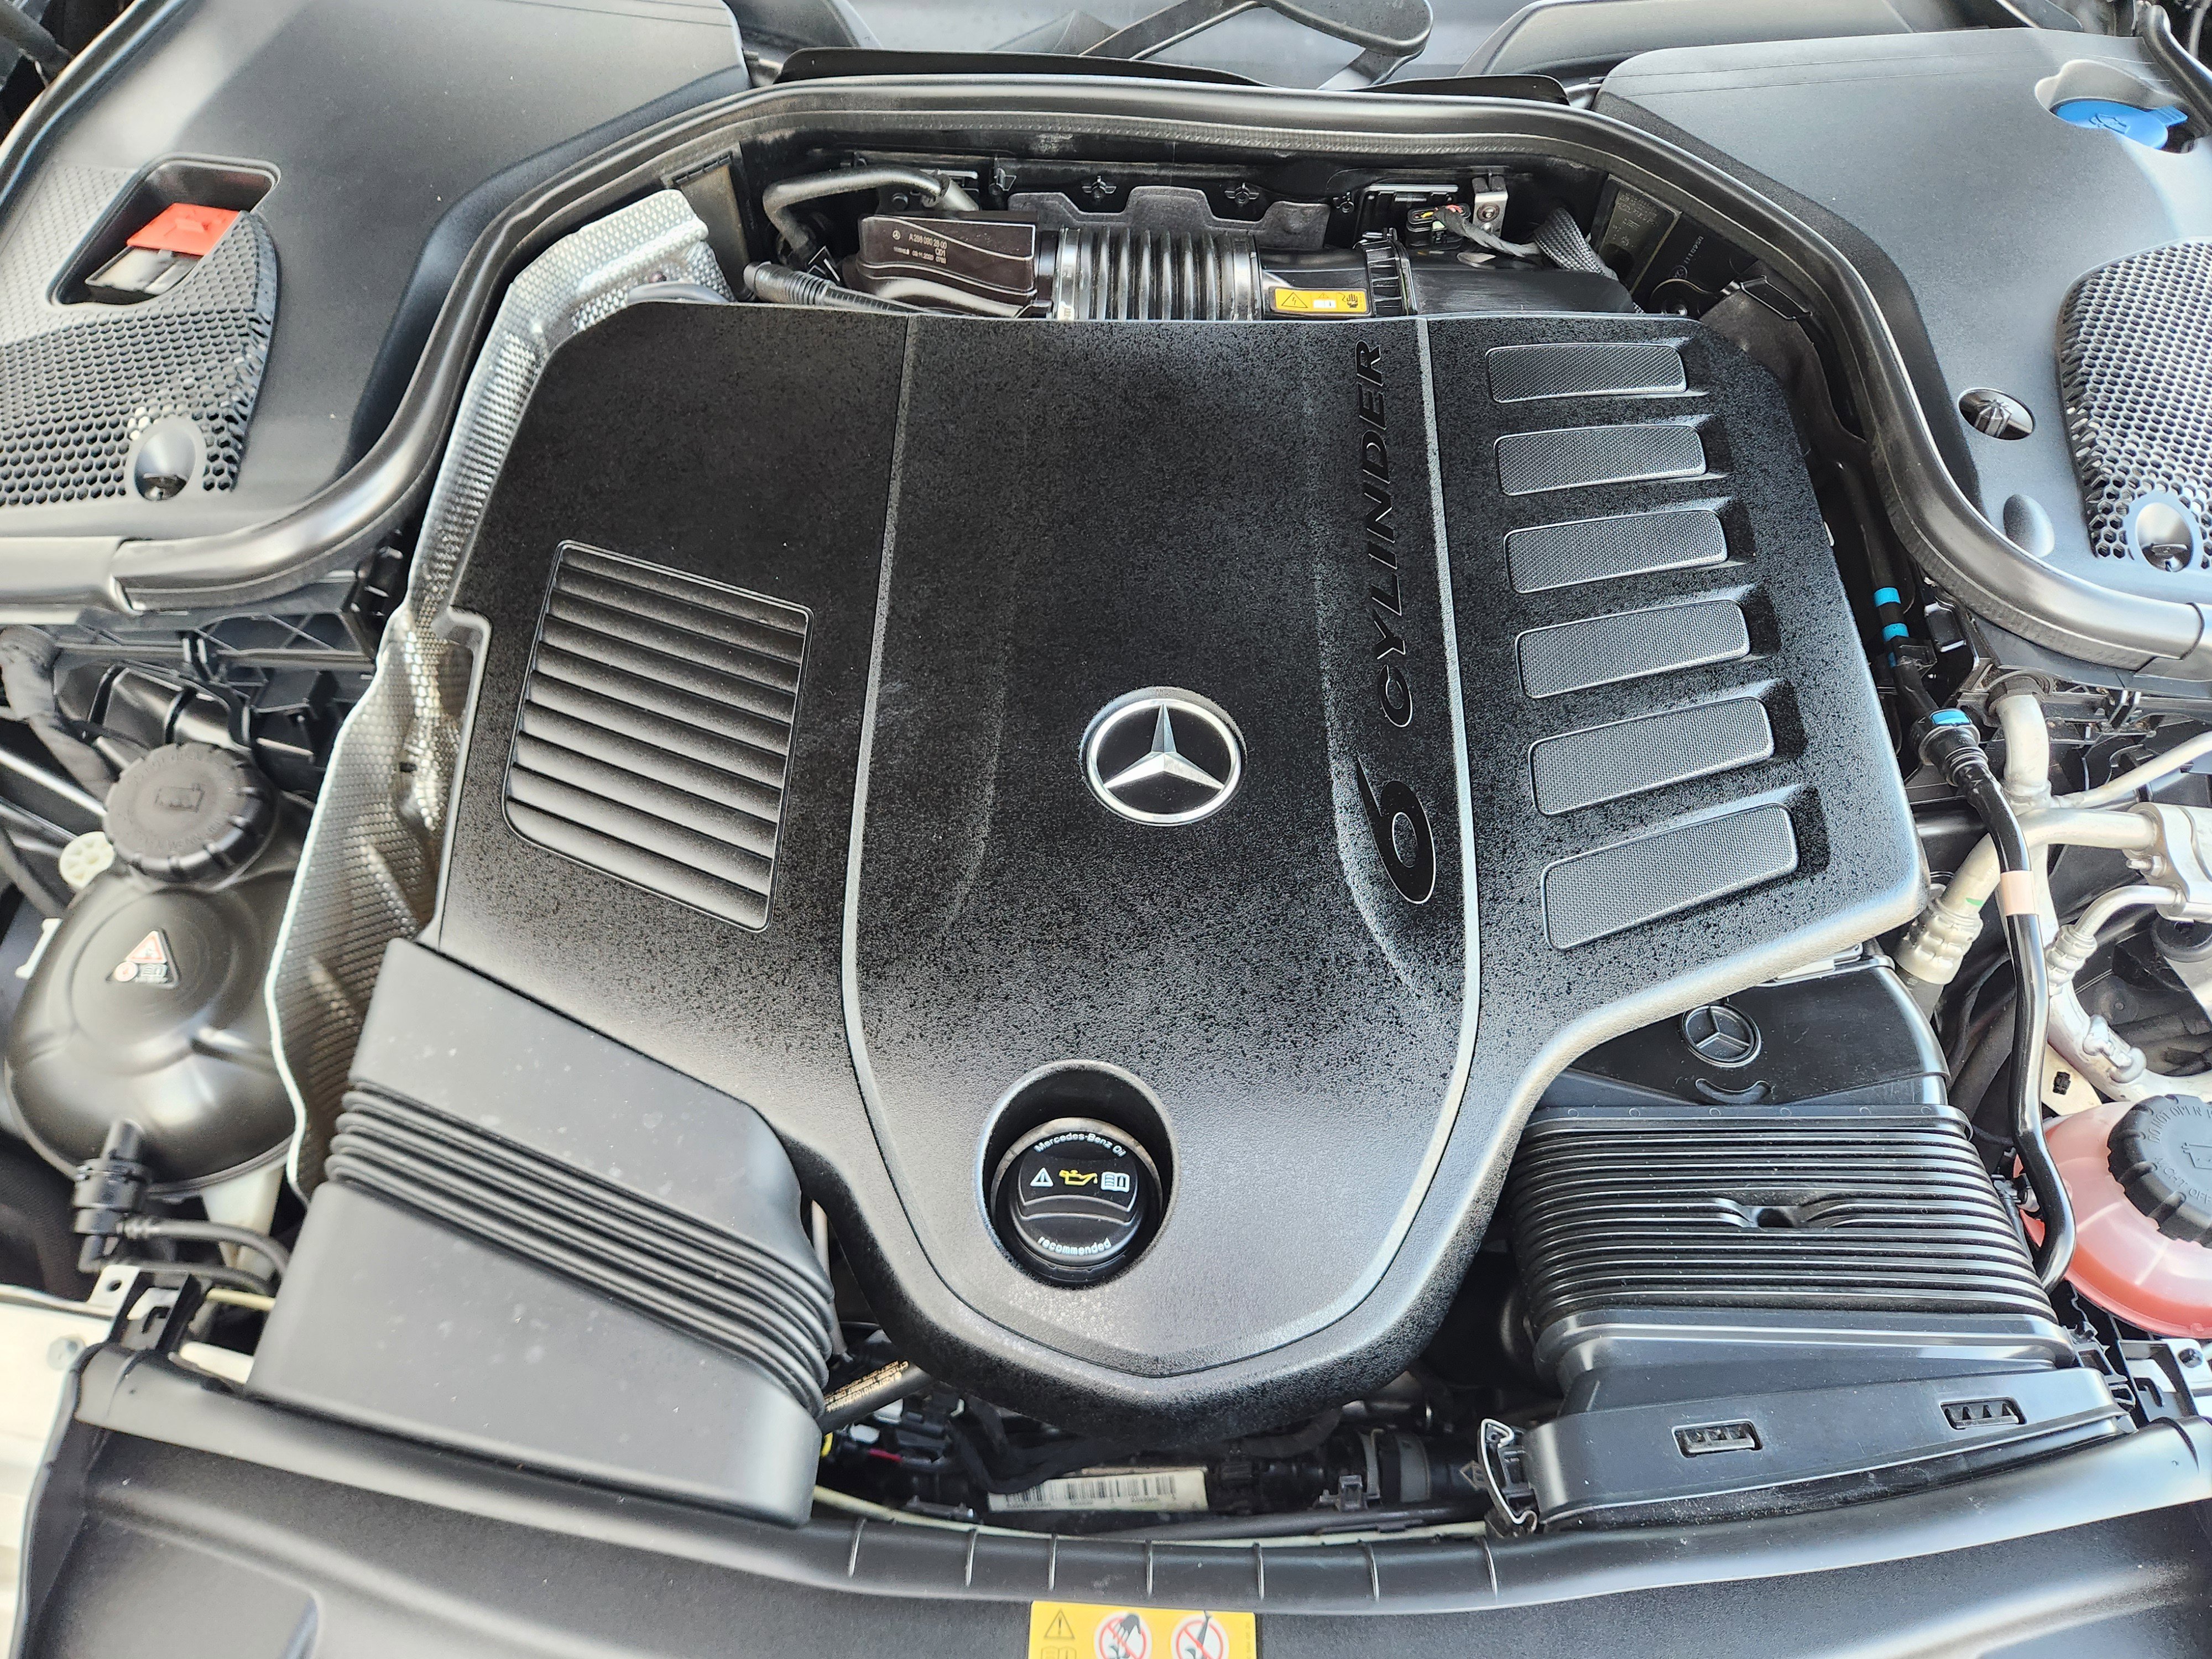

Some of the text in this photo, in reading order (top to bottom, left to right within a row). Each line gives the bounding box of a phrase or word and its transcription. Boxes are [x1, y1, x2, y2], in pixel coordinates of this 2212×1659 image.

[1355, 339, 1436, 905] 6 CYLINDER
[2151, 1112, 2171, 1129] NOT
[1033, 1132, 1127, 1157] Mercedes-Benz Oil
[2148, 1128, 2161, 1144] DO
[1037, 1237, 1112, 1255] recommended
